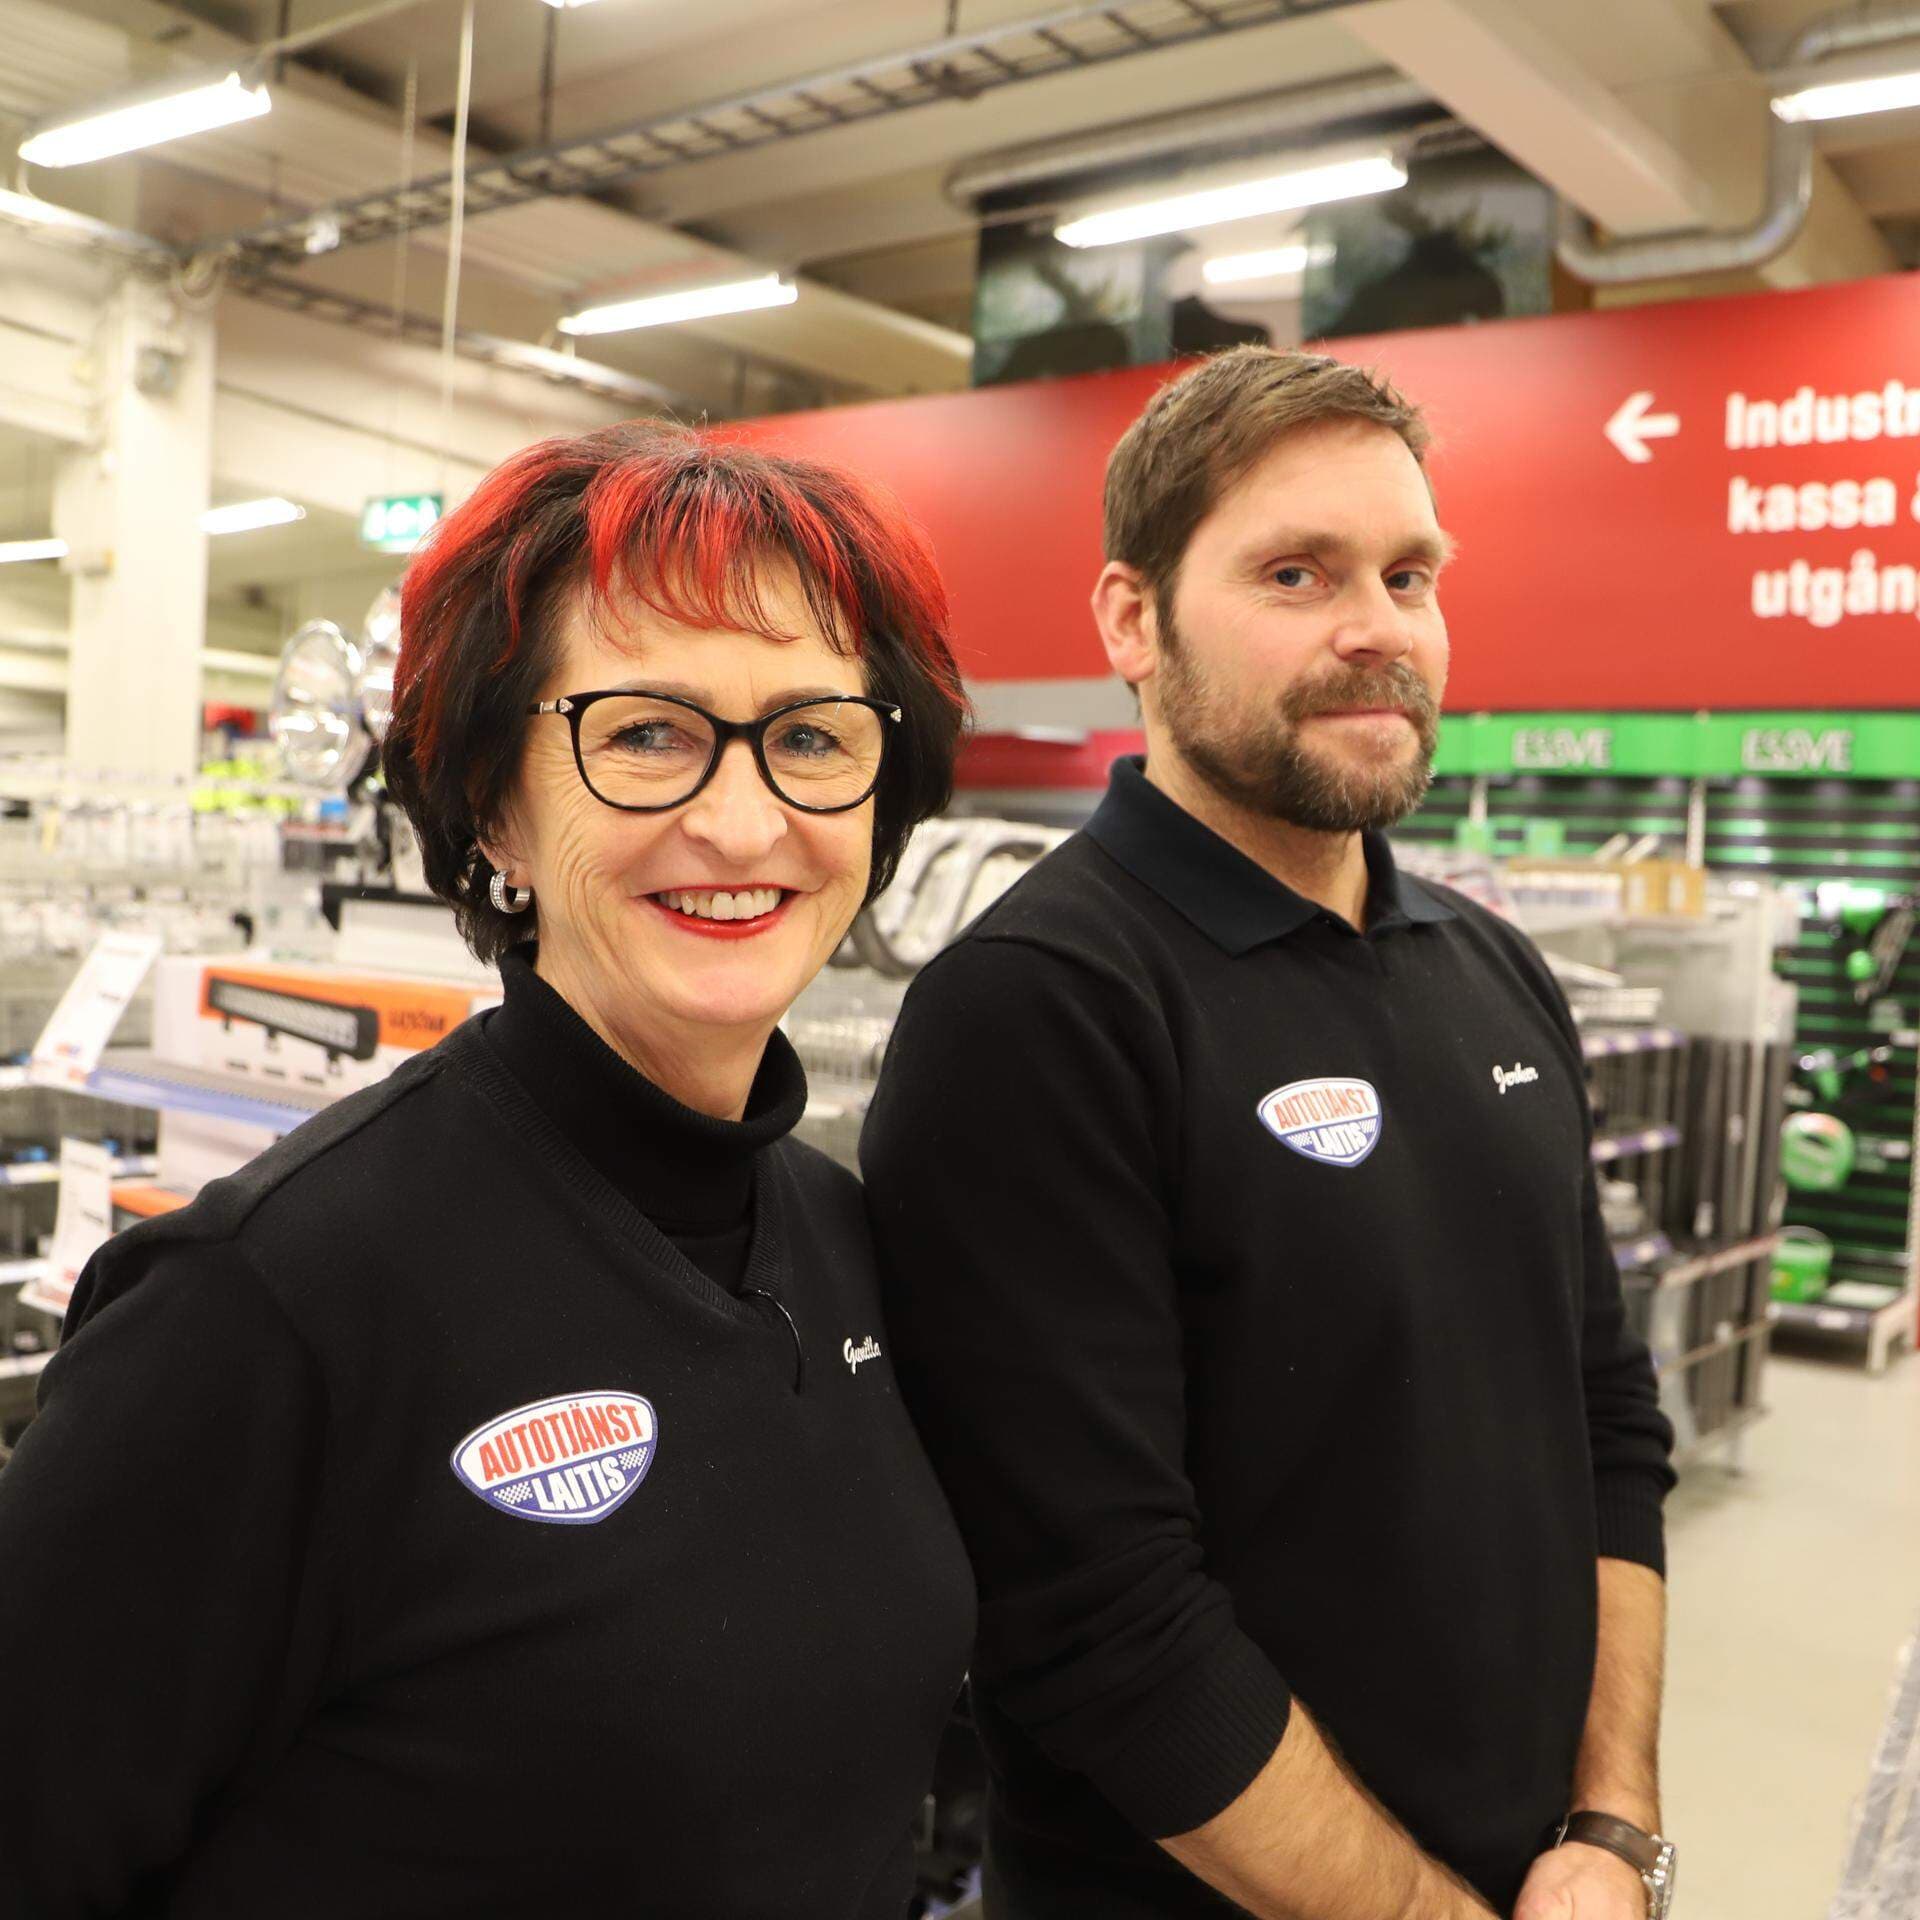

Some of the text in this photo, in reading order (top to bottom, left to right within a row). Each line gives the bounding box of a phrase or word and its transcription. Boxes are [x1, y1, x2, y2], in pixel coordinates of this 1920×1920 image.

[1726, 474, 1897, 534] kassa
[1751, 547, 1920, 628] utgån
[1512, 729, 1612, 769] ESSVE
[1741, 728, 1853, 772] ESSVE
[1274, 1085, 1370, 1129] AUTOTJÄNST
[1309, 1122, 1368, 1156] LAITIS
[843, 1335, 882, 1375] Gunilla
[479, 1402, 643, 1482] AUTOTJÄNST
[532, 1455, 626, 1511] LAITIS
